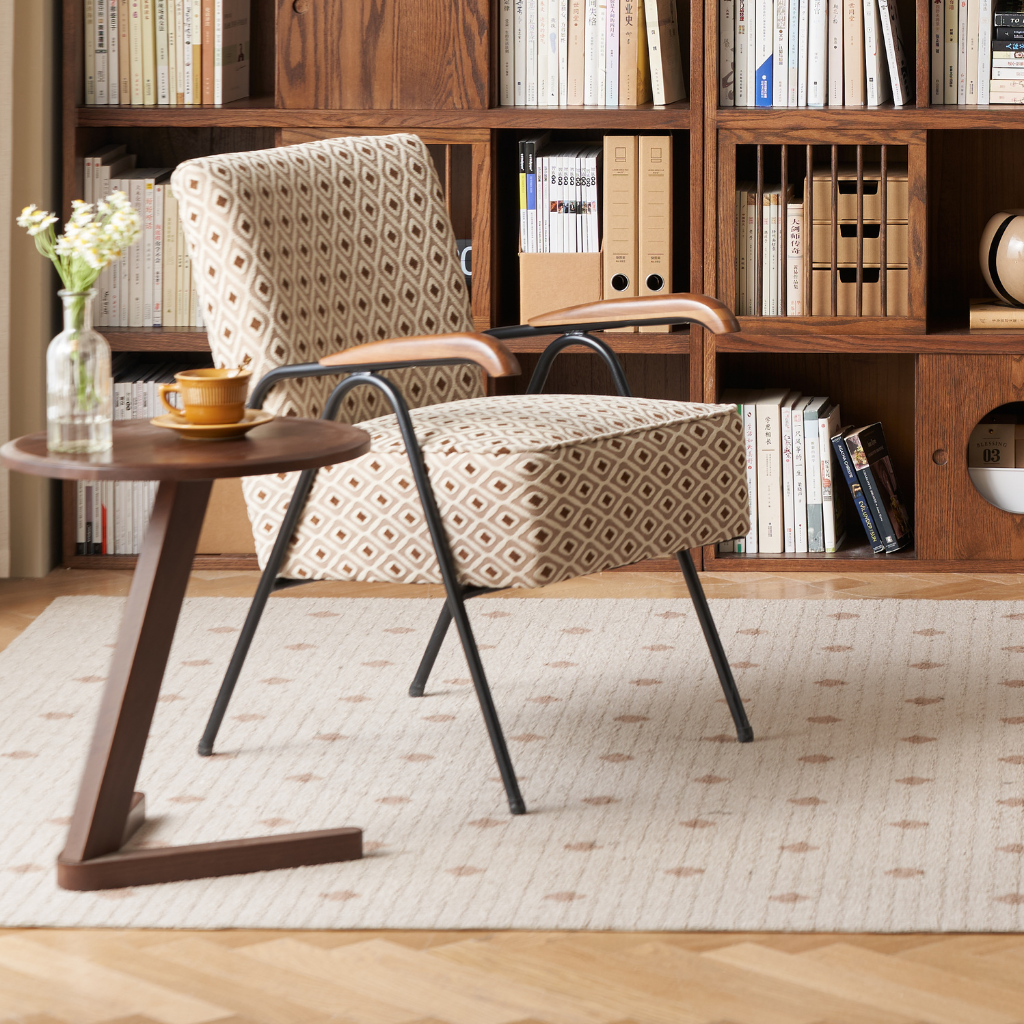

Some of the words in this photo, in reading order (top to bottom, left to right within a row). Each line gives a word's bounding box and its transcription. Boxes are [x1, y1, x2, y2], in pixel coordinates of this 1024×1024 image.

[790, 218, 800, 255] 大剑师传奇
[983, 448, 1001, 463] 03
